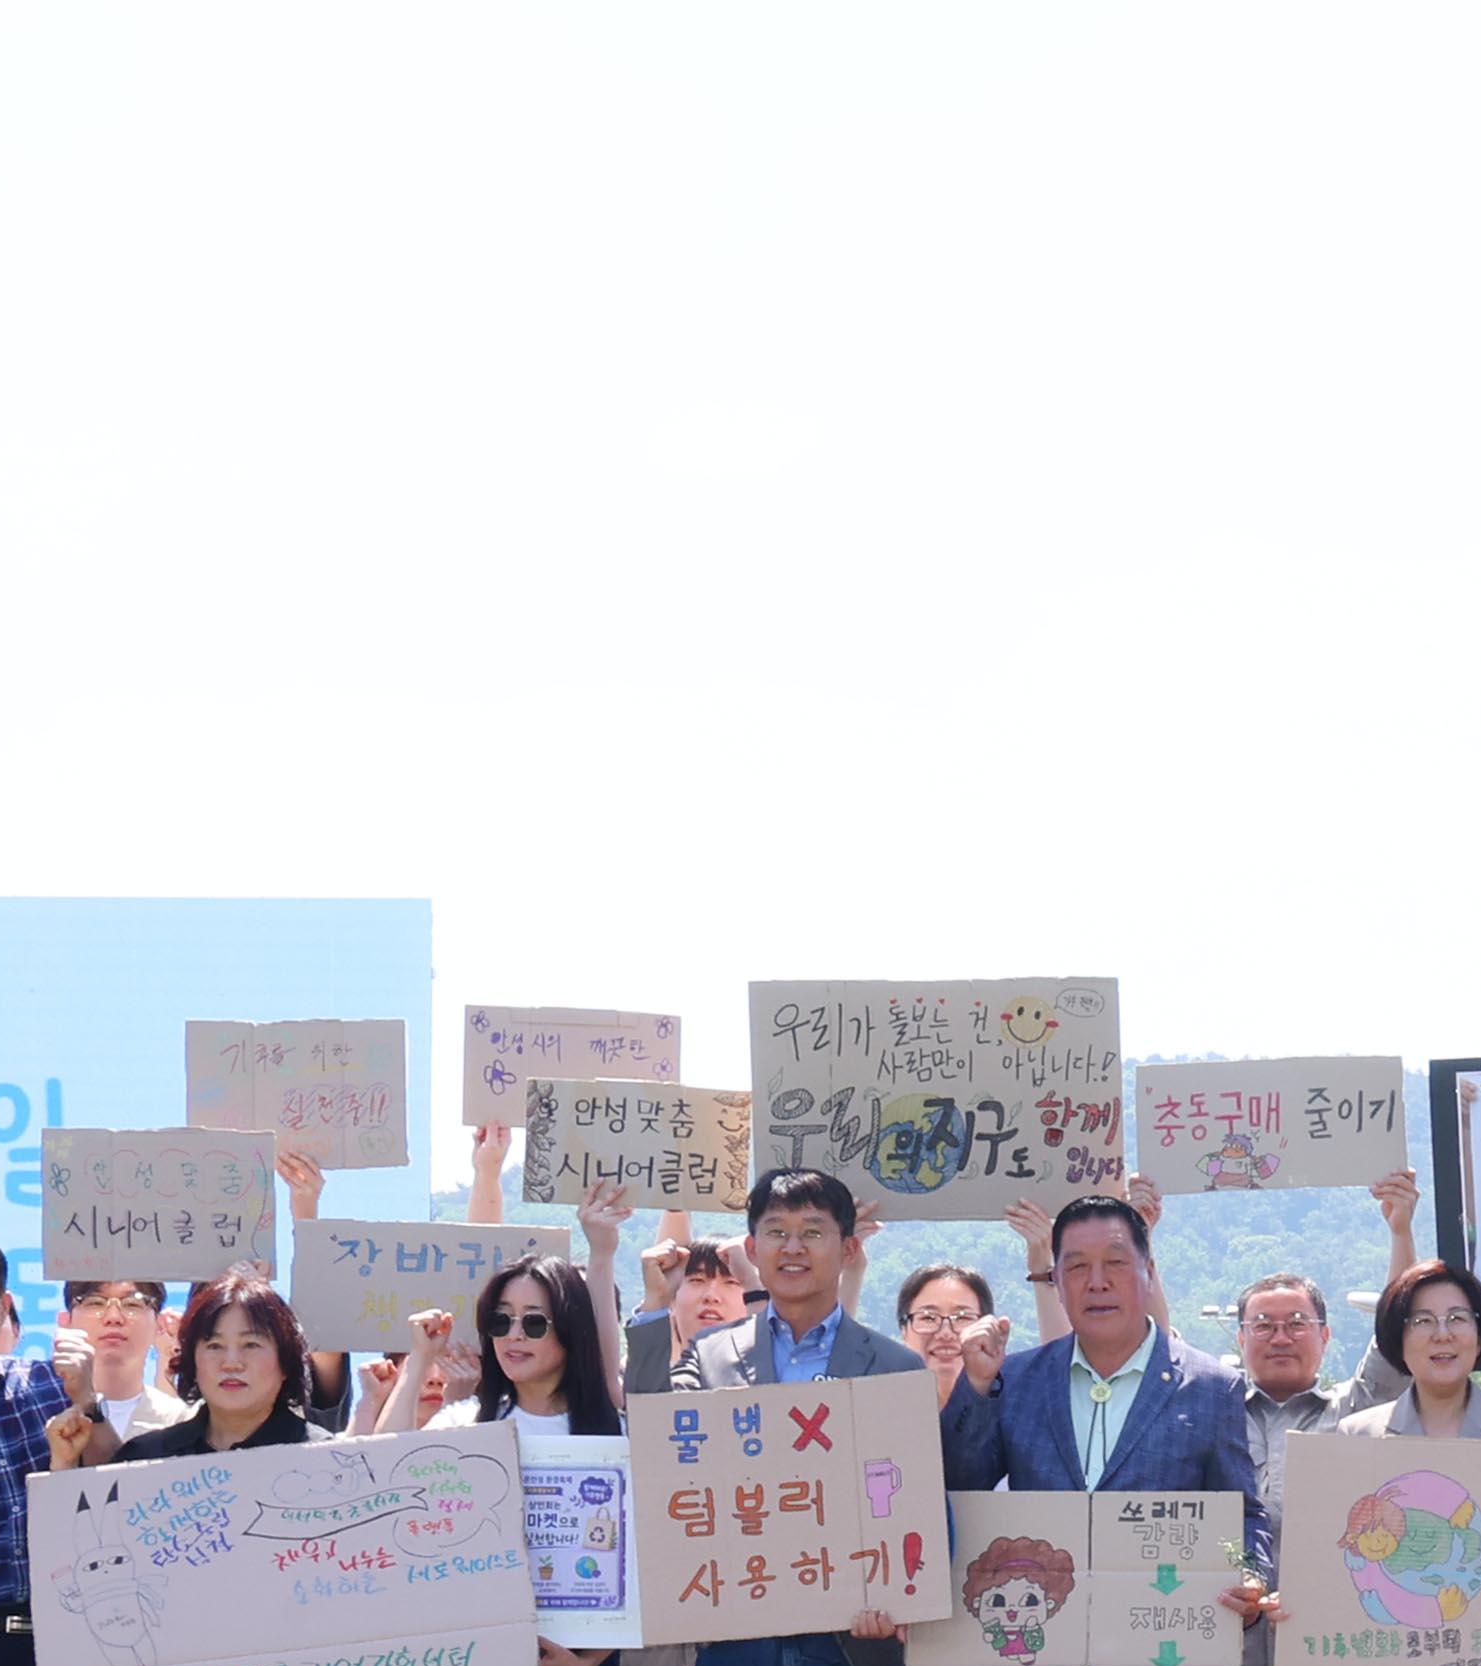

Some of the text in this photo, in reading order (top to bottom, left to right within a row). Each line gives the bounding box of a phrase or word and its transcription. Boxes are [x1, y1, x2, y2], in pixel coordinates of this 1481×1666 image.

[772, 998, 952, 1060] 우리가 돌보는
[876, 1044, 975, 1083] 사람만이
[575, 1097, 695, 1138] 안성맞춤
[1036, 1090, 1120, 1147] 함께
[1303, 1087, 1396, 1142] 줄이기
[556, 1150, 719, 1195] 시니어클럽
[1066, 1146, 1124, 1185] 입니다
[63, 1206, 242, 1248] 시니어클럽
[669, 1403, 762, 1464] 물병
[667, 1477, 826, 1538] 텀블러
[1118, 1500, 1204, 1522] 쓰레기
[1133, 1523, 1199, 1560] 감량
[678, 1531, 925, 1607] 사용하기!
[1130, 1605, 1217, 1640] 재사용
